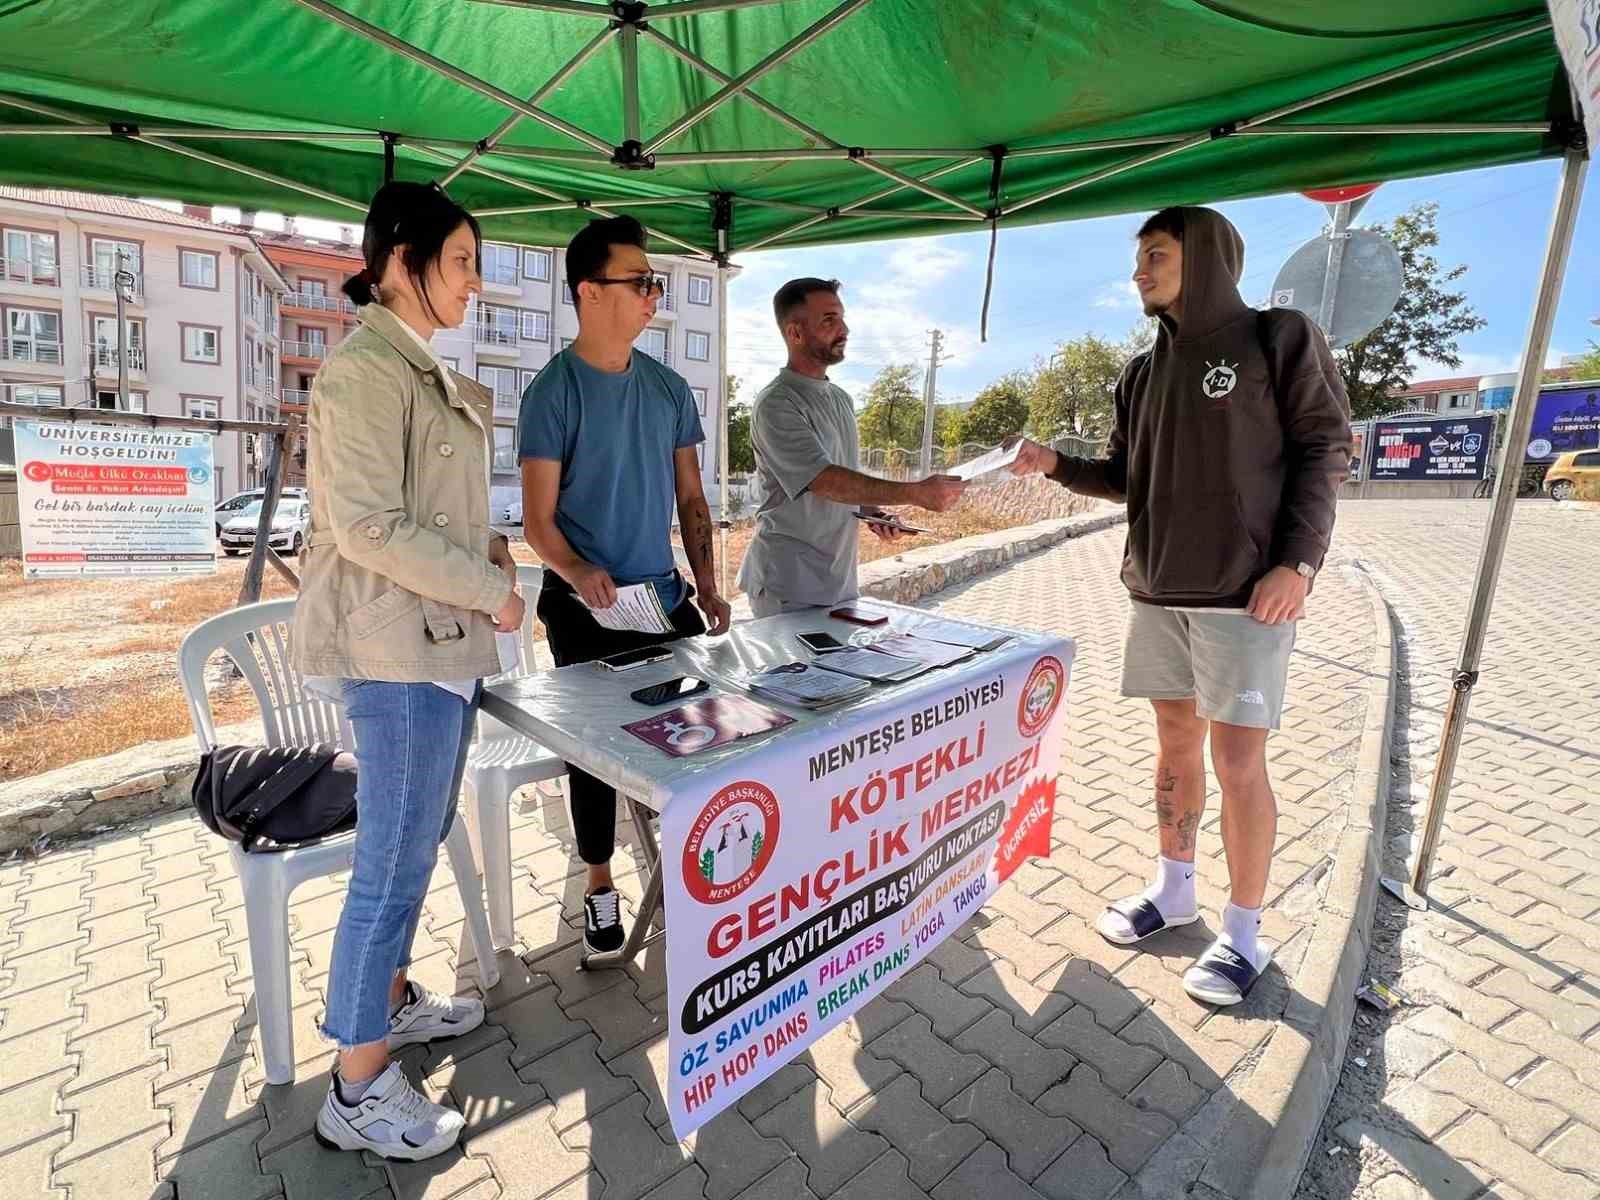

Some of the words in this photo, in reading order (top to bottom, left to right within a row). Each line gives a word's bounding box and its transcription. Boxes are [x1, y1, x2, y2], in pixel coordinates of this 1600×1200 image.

[39, 427, 193, 446] ÜNİVERSİTEMİZE
[60, 445, 176, 460] HOŞGELDİN!
[34, 499, 58, 511] Gel
[808, 719, 905, 782] MENTEŞE
[911, 674, 1004, 737] BELEDİYESİ
[830, 720, 986, 833] KÖTEKLİ
[688, 796, 728, 853] BELEDİYE
[707, 822, 911, 959] GENÇLİK
[920, 736, 1041, 843] MERKEZİ
[1003, 796, 1050, 861] ÜCRETSİZ
[679, 1041, 709, 1077] ÖZ
[715, 979, 809, 1054] SAVUNMA
[819, 932, 886, 986] PİLATES
[901, 895, 933, 938] LATİN
[936, 852, 988, 904] DANSLARI
[696, 961, 761, 1022] KURS
[767, 895, 869, 978] KAYITLARI
[874, 851, 942, 914] BAŞVURU
[946, 808, 1000, 862] NOKTASI
[684, 1072, 717, 1114] HİP
[722, 1044, 758, 1088] HOP
[763, 1012, 809, 1058] DANS
[817, 969, 870, 1021] BREAK
[873, 943, 911, 983] DANS
[914, 911, 945, 950] YOGA
[952, 872, 987, 914] TANGO
